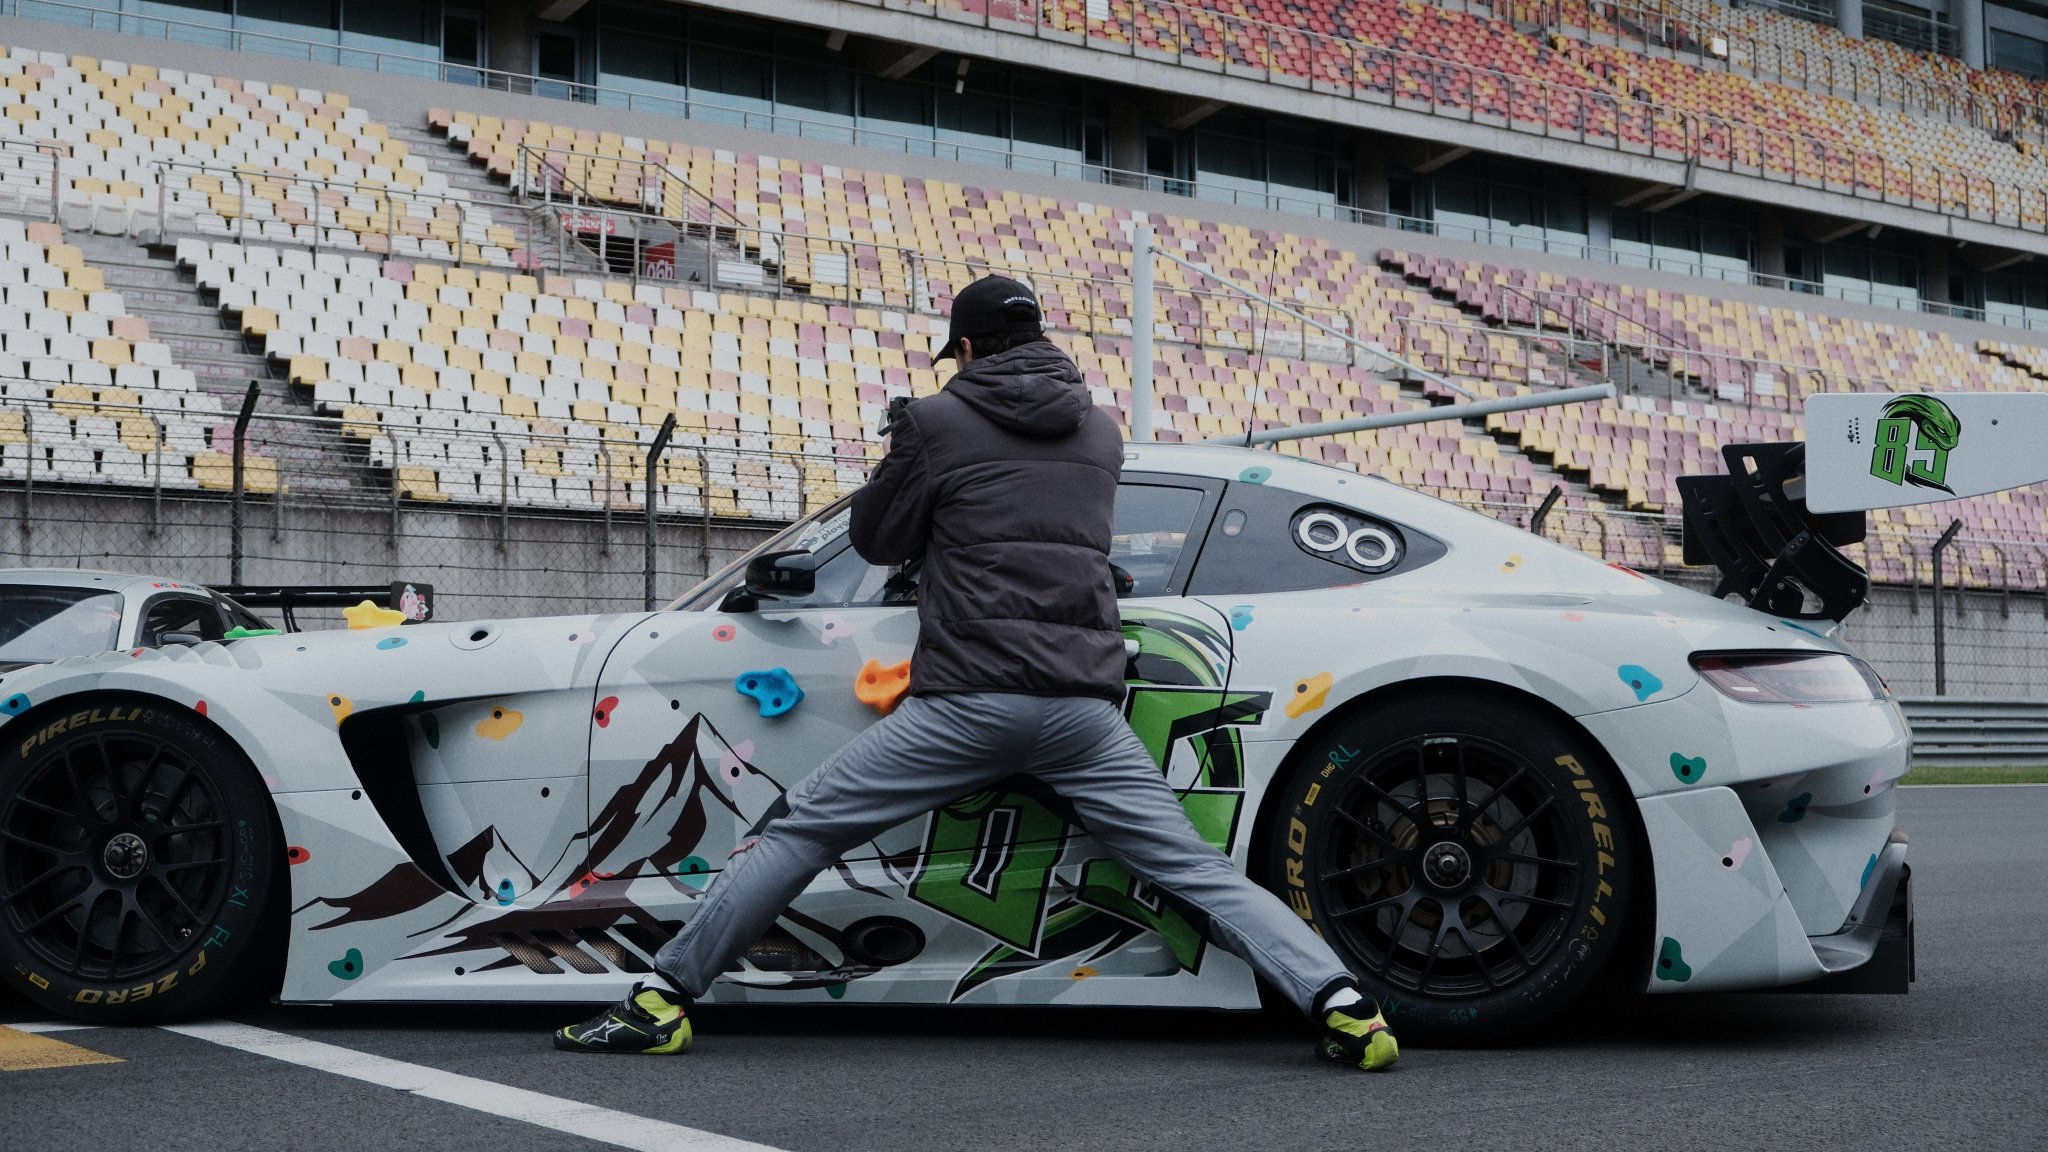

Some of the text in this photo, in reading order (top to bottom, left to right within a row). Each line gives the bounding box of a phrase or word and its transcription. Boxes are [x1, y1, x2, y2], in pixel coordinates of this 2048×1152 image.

[1870, 418, 1949, 486] 85
[821, 517, 850, 541] playg
[21, 707, 143, 759] PIRELLI
[1321, 762, 1336, 779] DHG
[1328, 744, 1360, 770] RL
[1554, 754, 1615, 926] PIRELLI
[1286, 817, 1325, 942] ERO
[203, 924, 231, 950] FL
[188, 950, 208, 977] P
[74, 970, 180, 1006] ZERO
